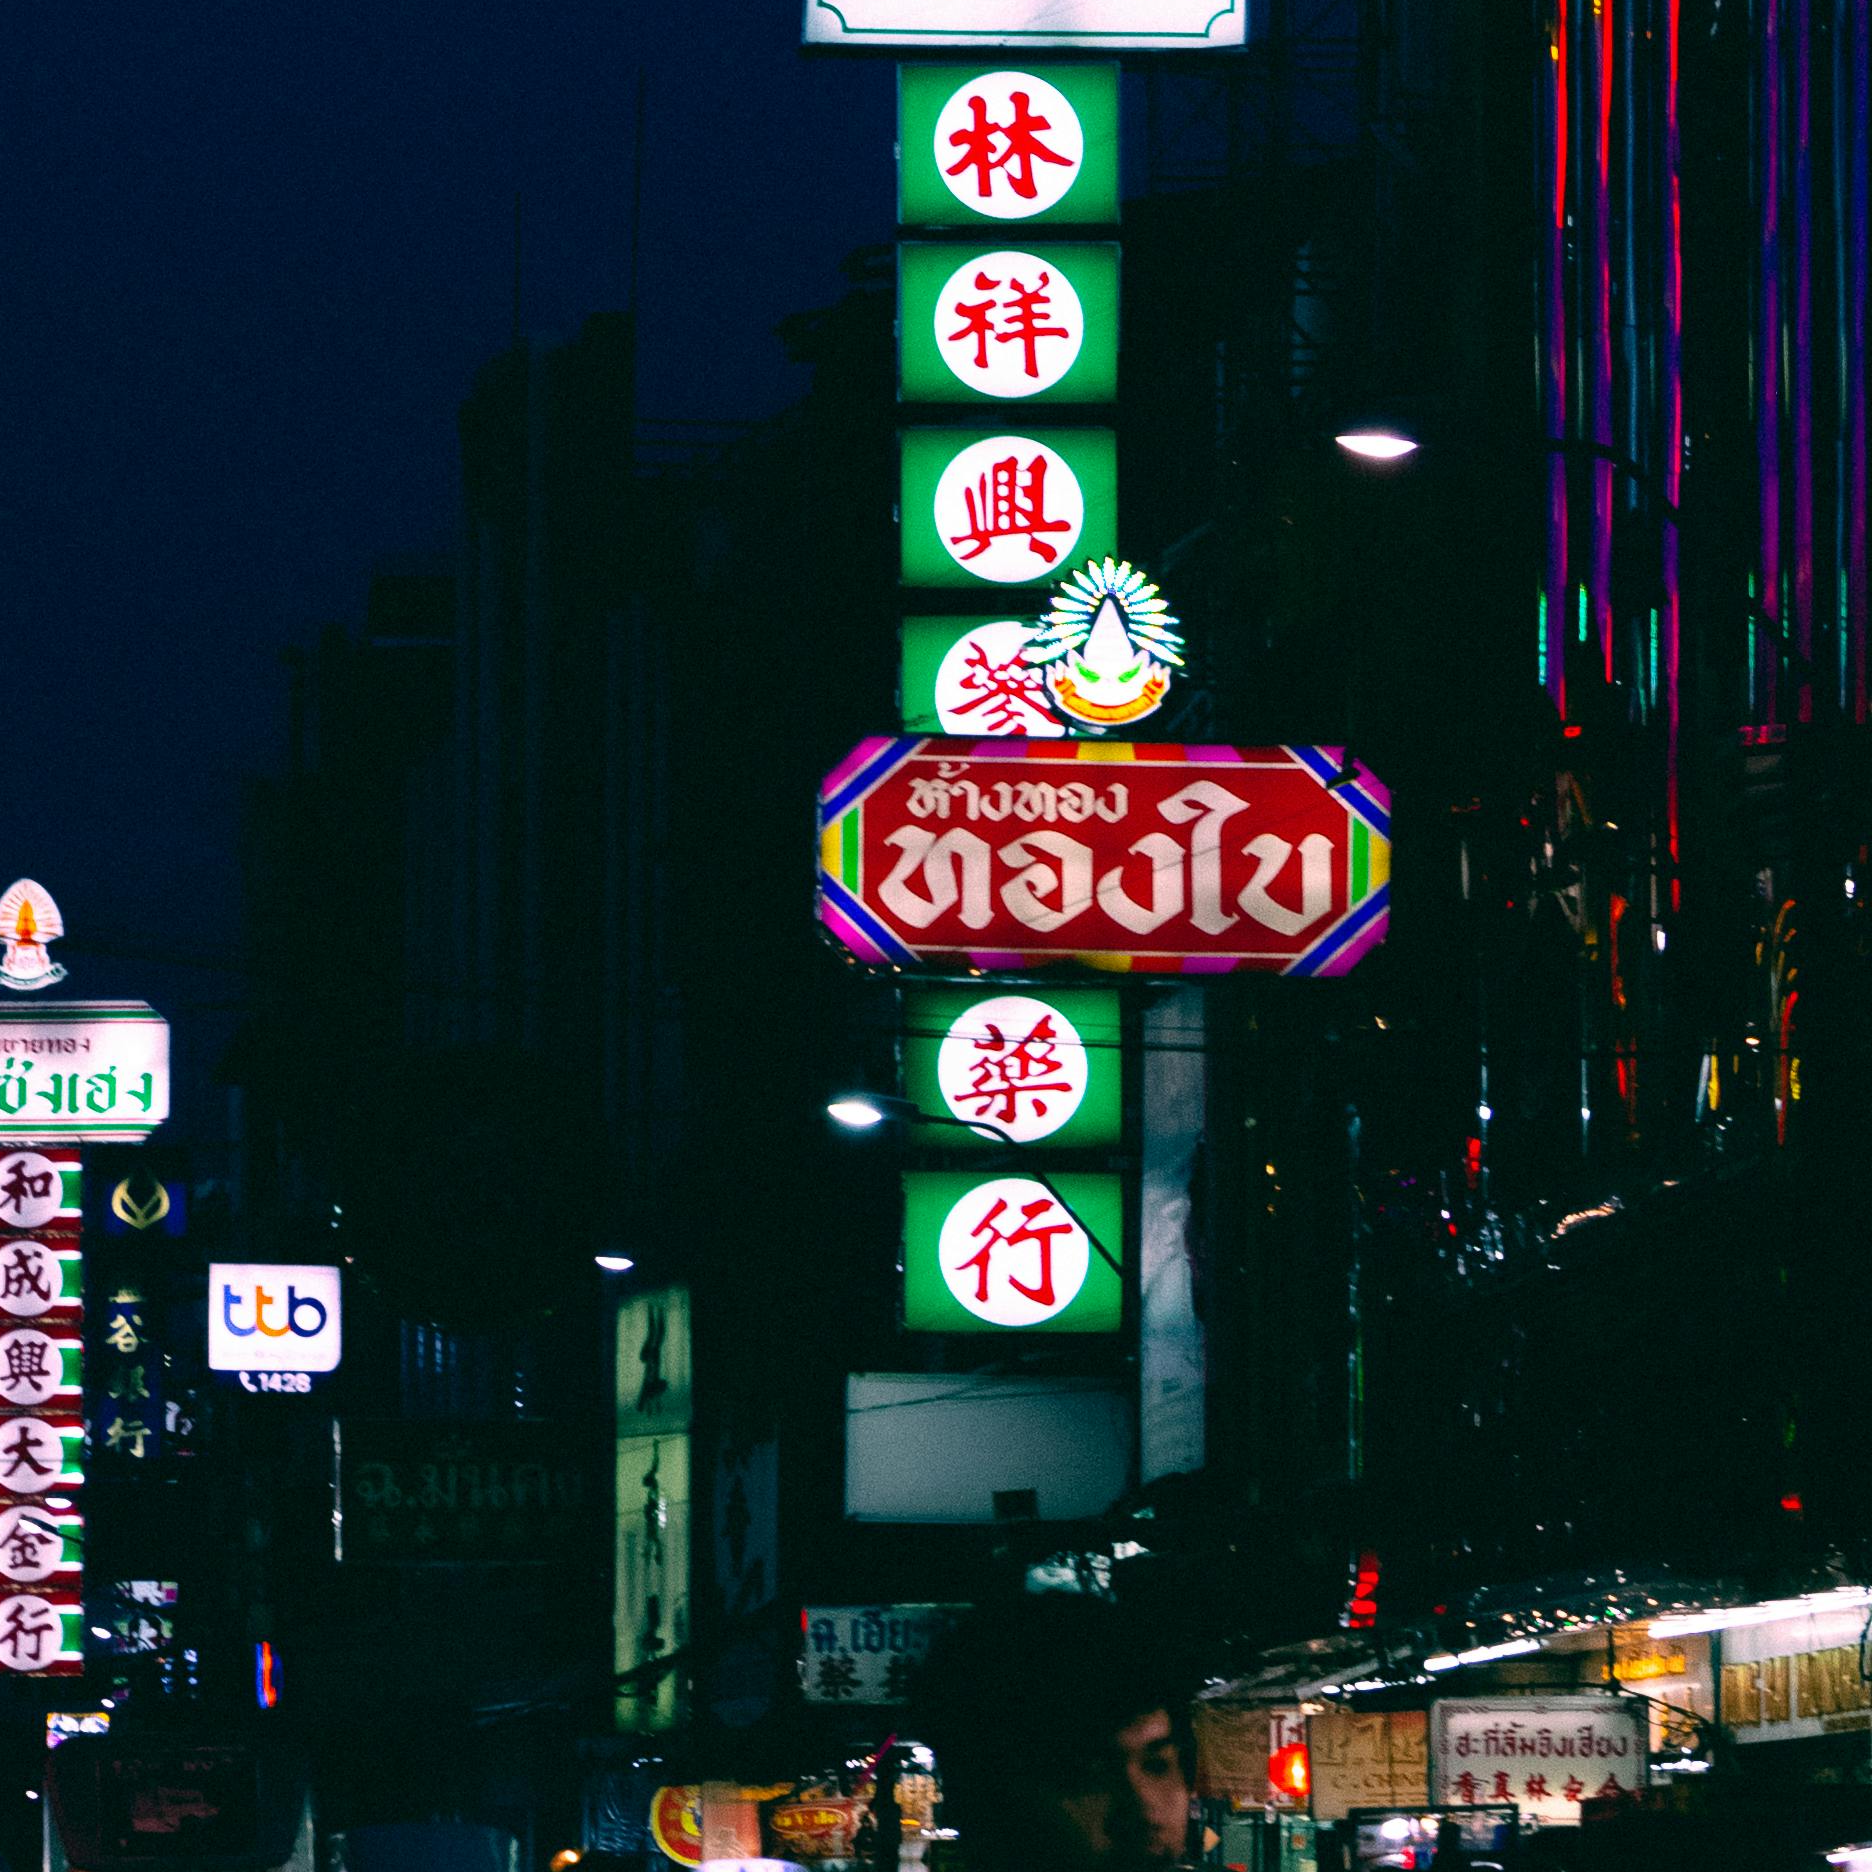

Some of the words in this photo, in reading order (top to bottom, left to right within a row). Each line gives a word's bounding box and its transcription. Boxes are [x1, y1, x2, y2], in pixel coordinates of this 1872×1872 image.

[907, 762, 1128, 825] ห้างทอง
[876, 780, 1334, 935] ทองใบ
[223, 1284, 327, 1338] ttb
[258, 1373, 311, 1393] 1428
